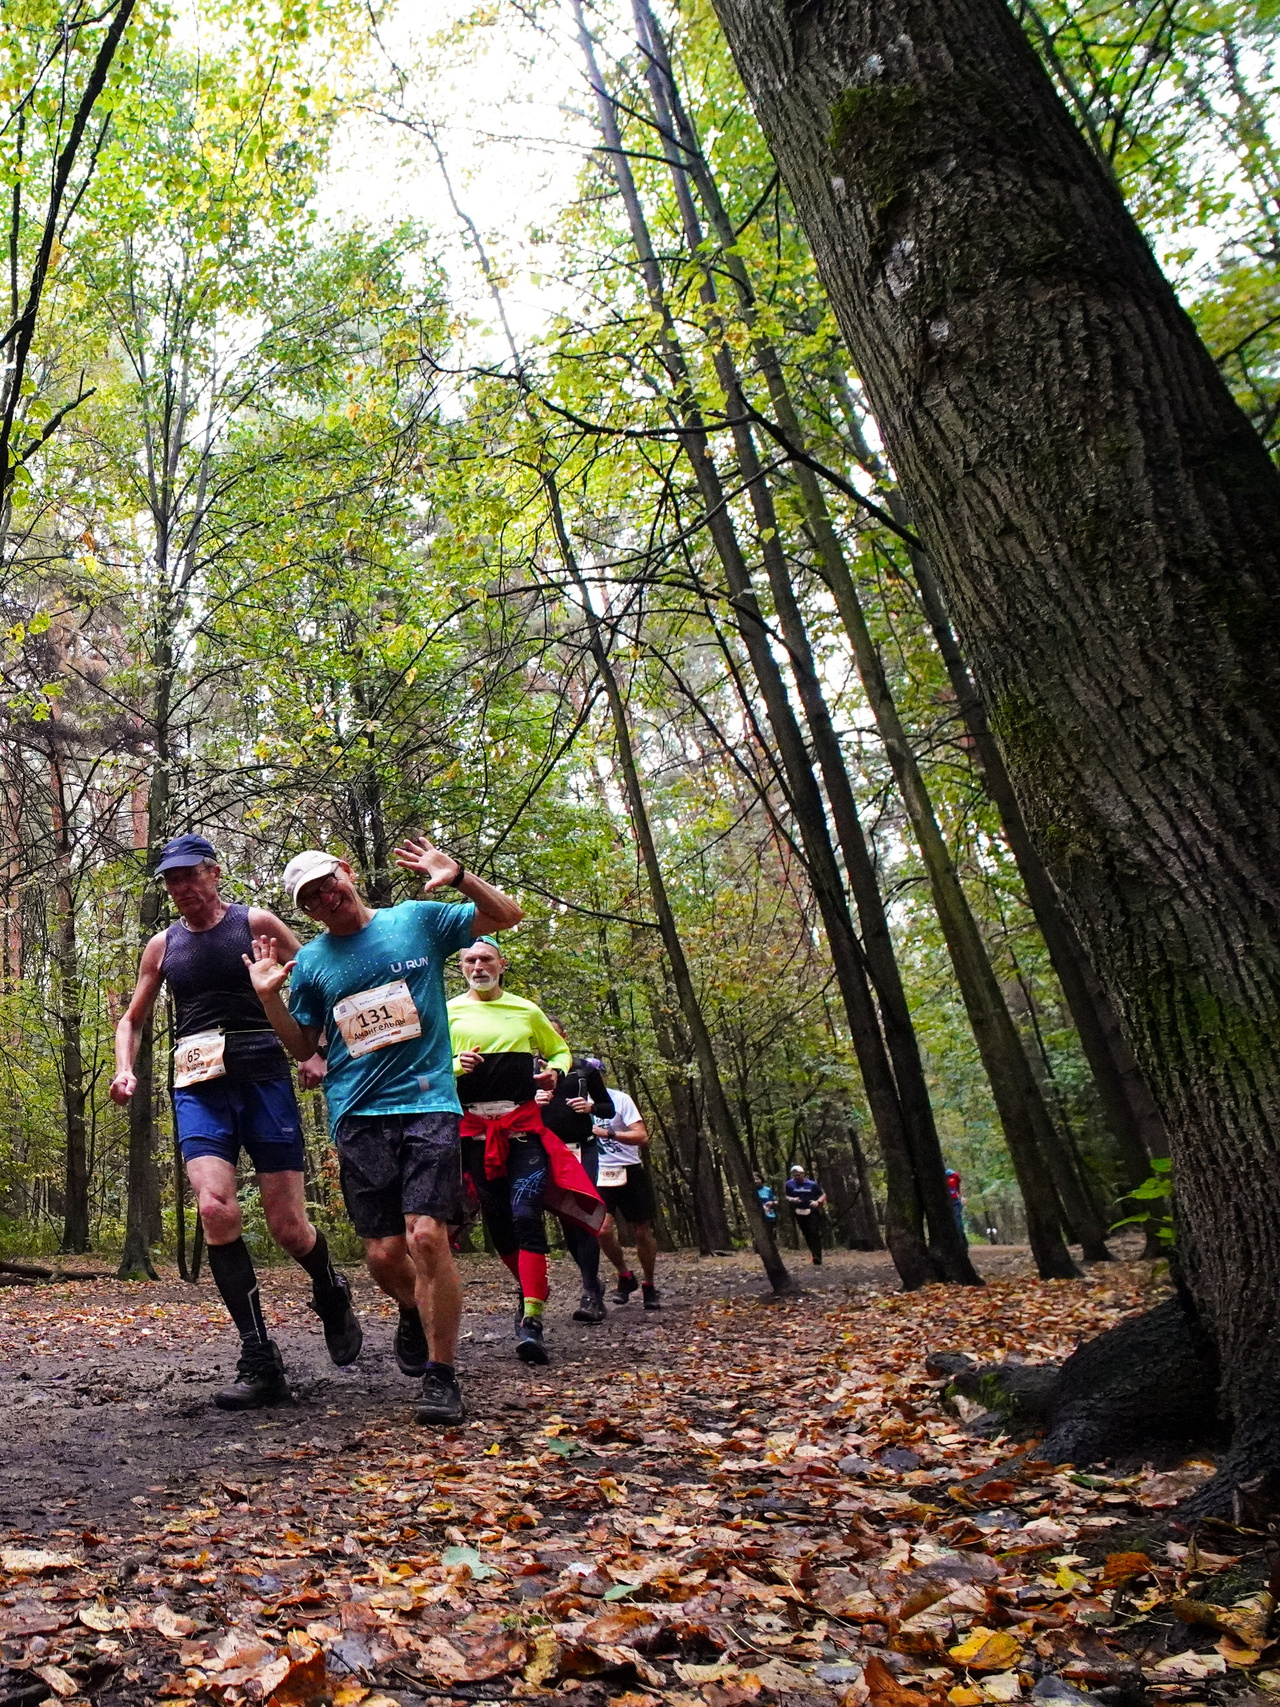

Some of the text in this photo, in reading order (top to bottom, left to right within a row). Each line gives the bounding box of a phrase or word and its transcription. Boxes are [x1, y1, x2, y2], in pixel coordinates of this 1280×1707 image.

[406, 956, 429, 970] RUN
[358, 1005, 393, 1028] 131
[354, 1018, 406, 1040] Амангельды
[187, 1048, 200, 1063] 65
